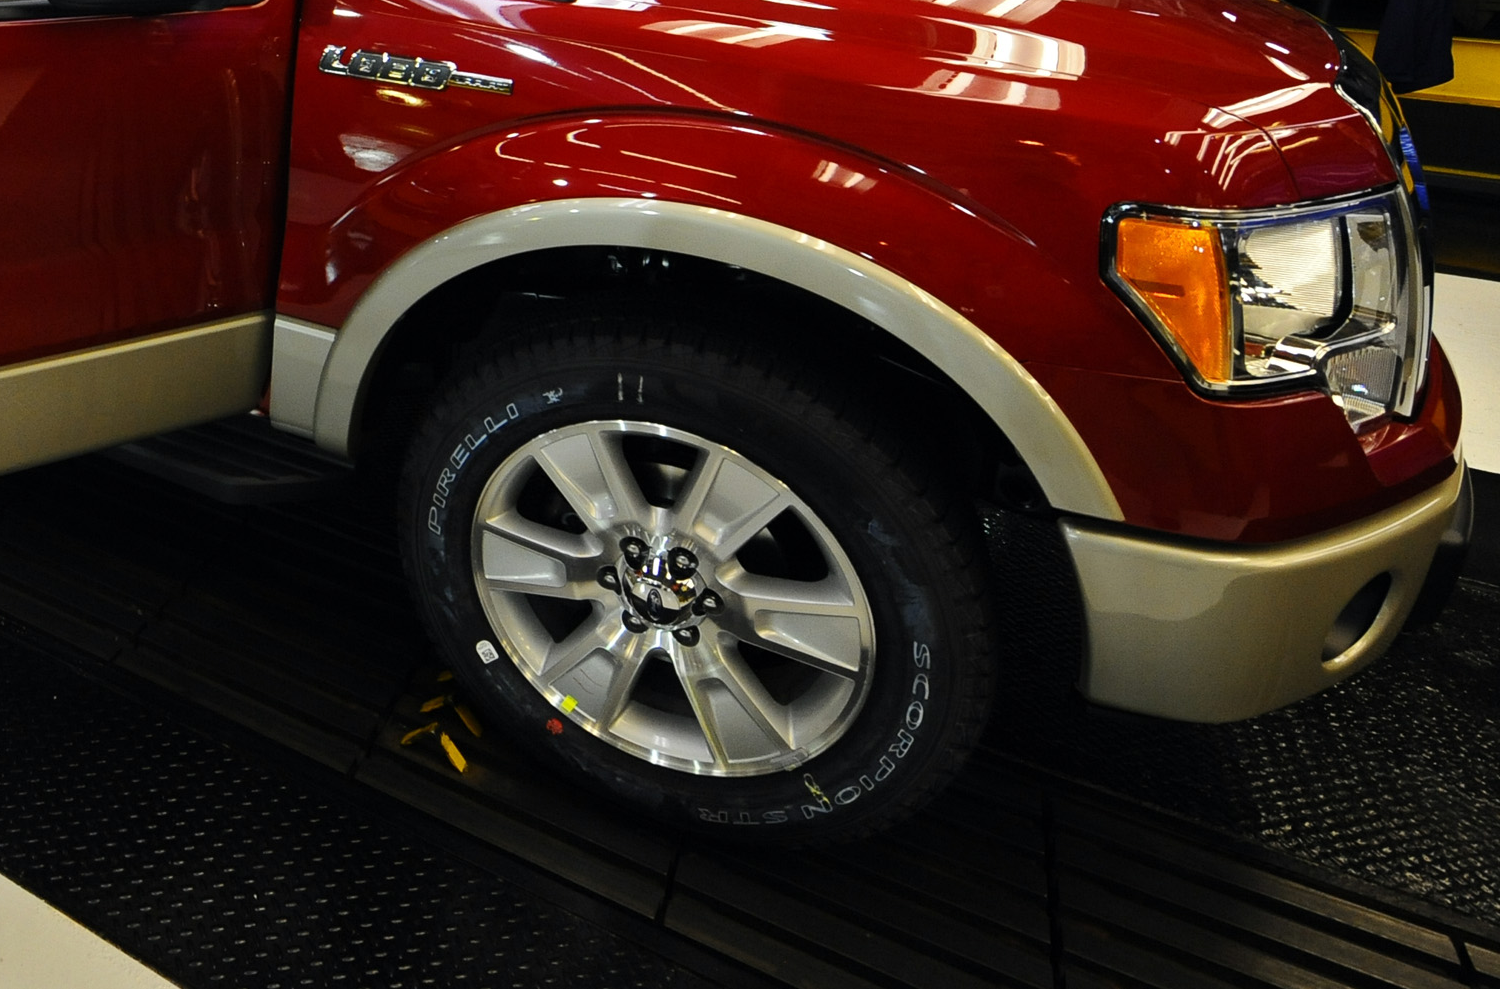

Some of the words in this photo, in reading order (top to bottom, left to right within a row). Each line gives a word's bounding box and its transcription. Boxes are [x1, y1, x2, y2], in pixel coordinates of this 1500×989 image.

[428, 402, 519, 536] PIRELLI
[801, 640, 931, 820] SCORPION
[698, 808, 788, 824] STR
